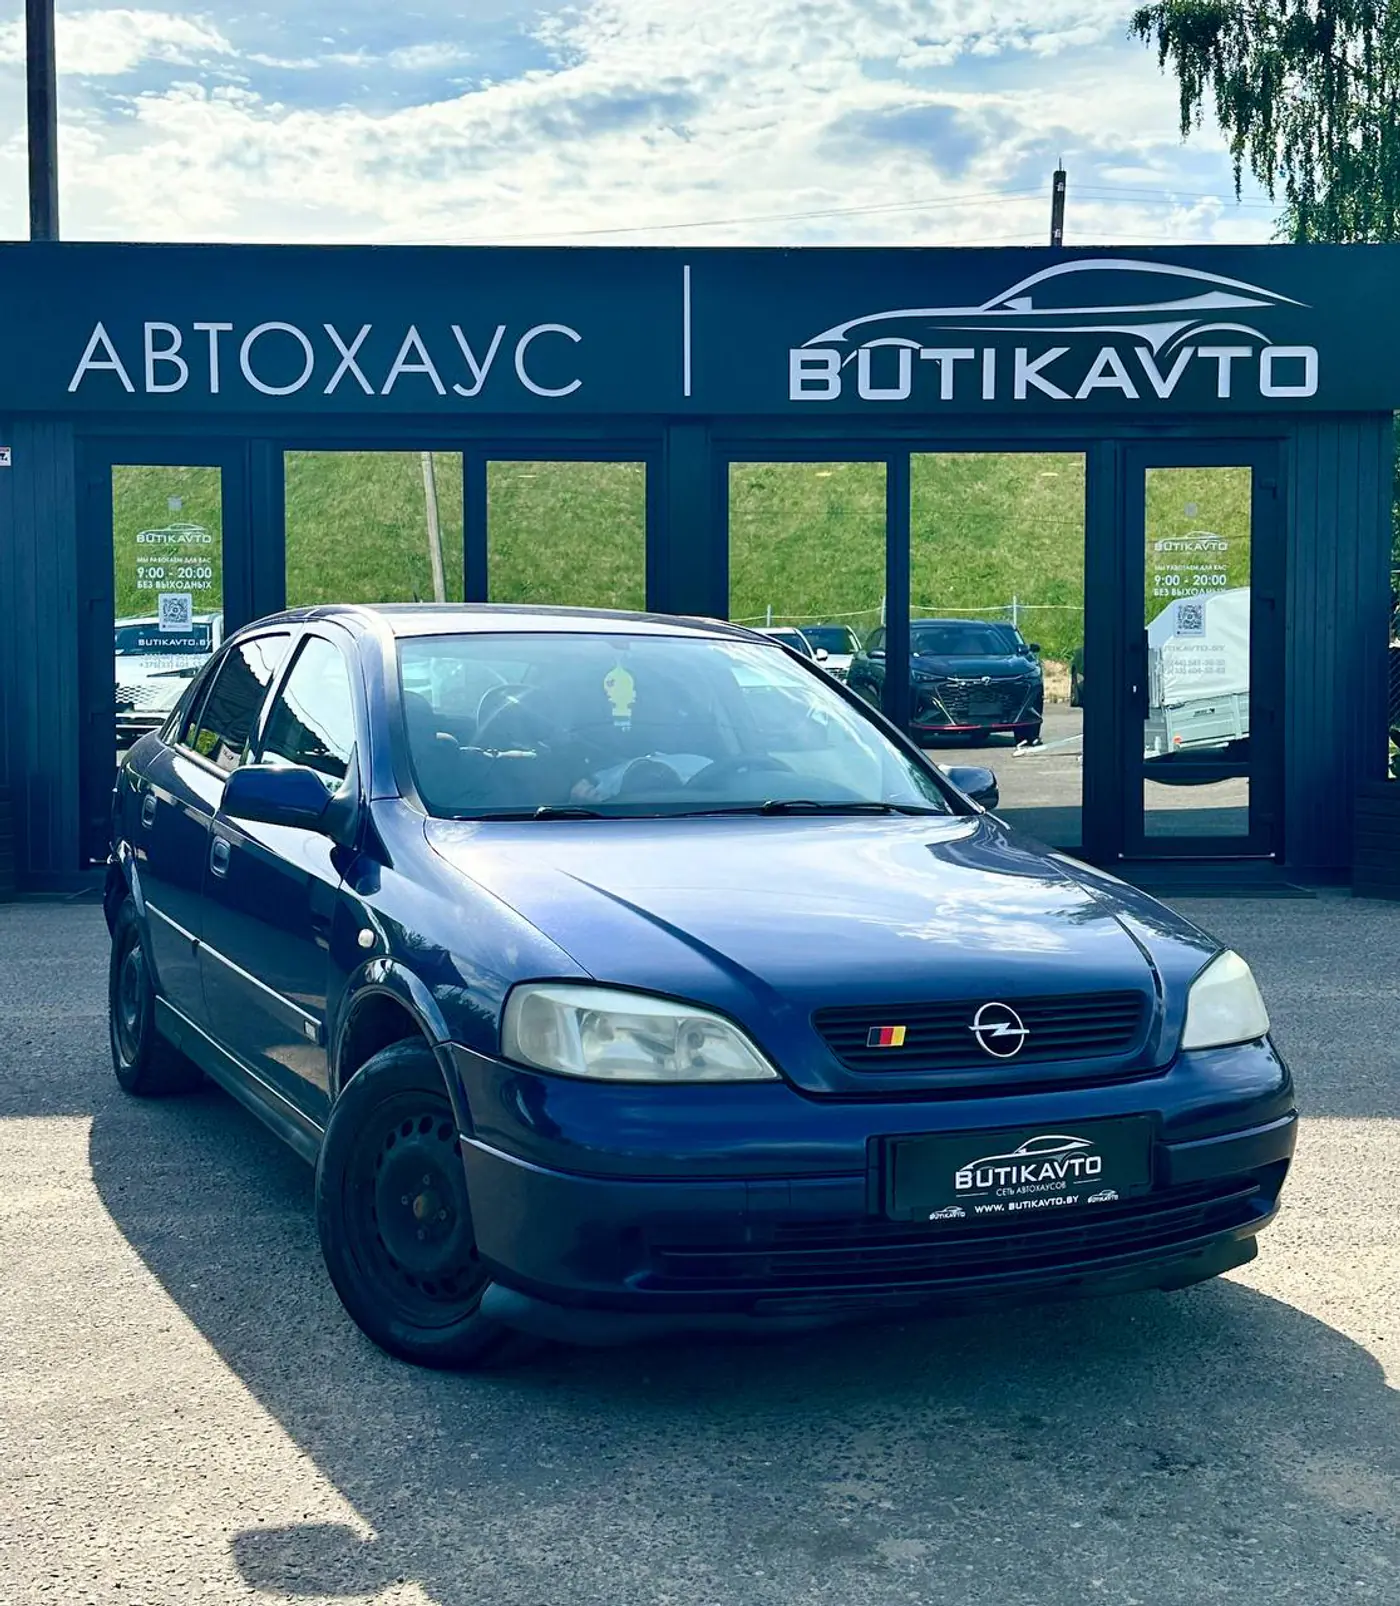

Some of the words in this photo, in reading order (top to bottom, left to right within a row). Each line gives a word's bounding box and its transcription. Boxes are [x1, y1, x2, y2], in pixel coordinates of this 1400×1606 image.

[68, 321, 583, 397] АВТОХАУС
[789, 345, 1319, 401] BUTIKAVTO
[136, 534, 212, 543] BUTIKAVTO
[1154, 542, 1228, 551] BUTIKAVTO
[137, 567, 164, 579] 9:00
[178, 567, 212, 579] 20:00
[137, 581, 153, 589] БЕЗ
[156, 581, 212, 590] ВЫХОДНЫХ
[1154, 575, 1180, 586] 9:00
[1193, 575, 1227, 586] 20:00
[1154, 588, 1169, 596] БЕЗ
[955, 1156, 1102, 1190] BUTIKAVTO
[1016, 1181, 1067, 1195] АВТОХАУСОВ
[974, 1204, 1005, 1214] WWW.
[1008, 1195, 1080, 1211] BUTIKAVTO.BY
